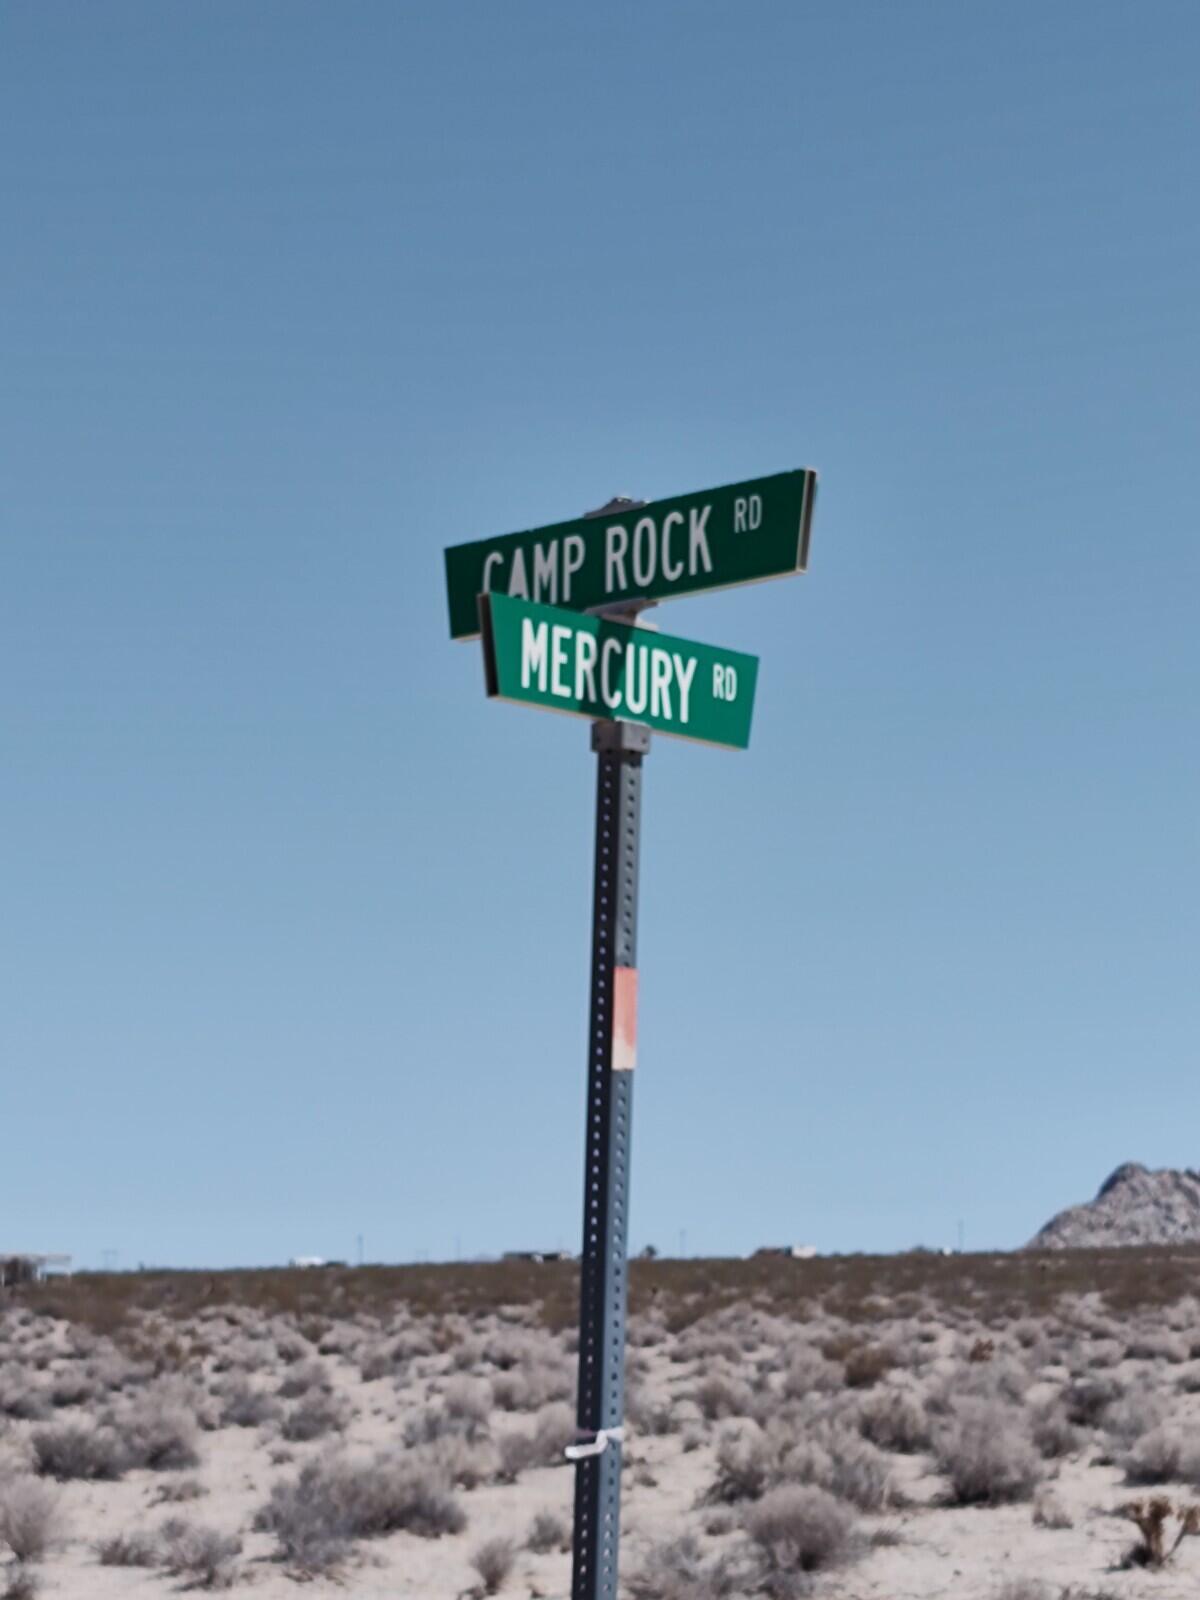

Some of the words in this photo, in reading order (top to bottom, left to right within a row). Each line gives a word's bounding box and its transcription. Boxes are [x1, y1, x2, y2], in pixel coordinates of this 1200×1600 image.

[483, 535, 586, 604] CAMP
[605, 505, 713, 593] ROCK
[734, 495, 762, 533] RD
[521, 617, 697, 724] MERCURY
[712, 663, 737, 701] RD
